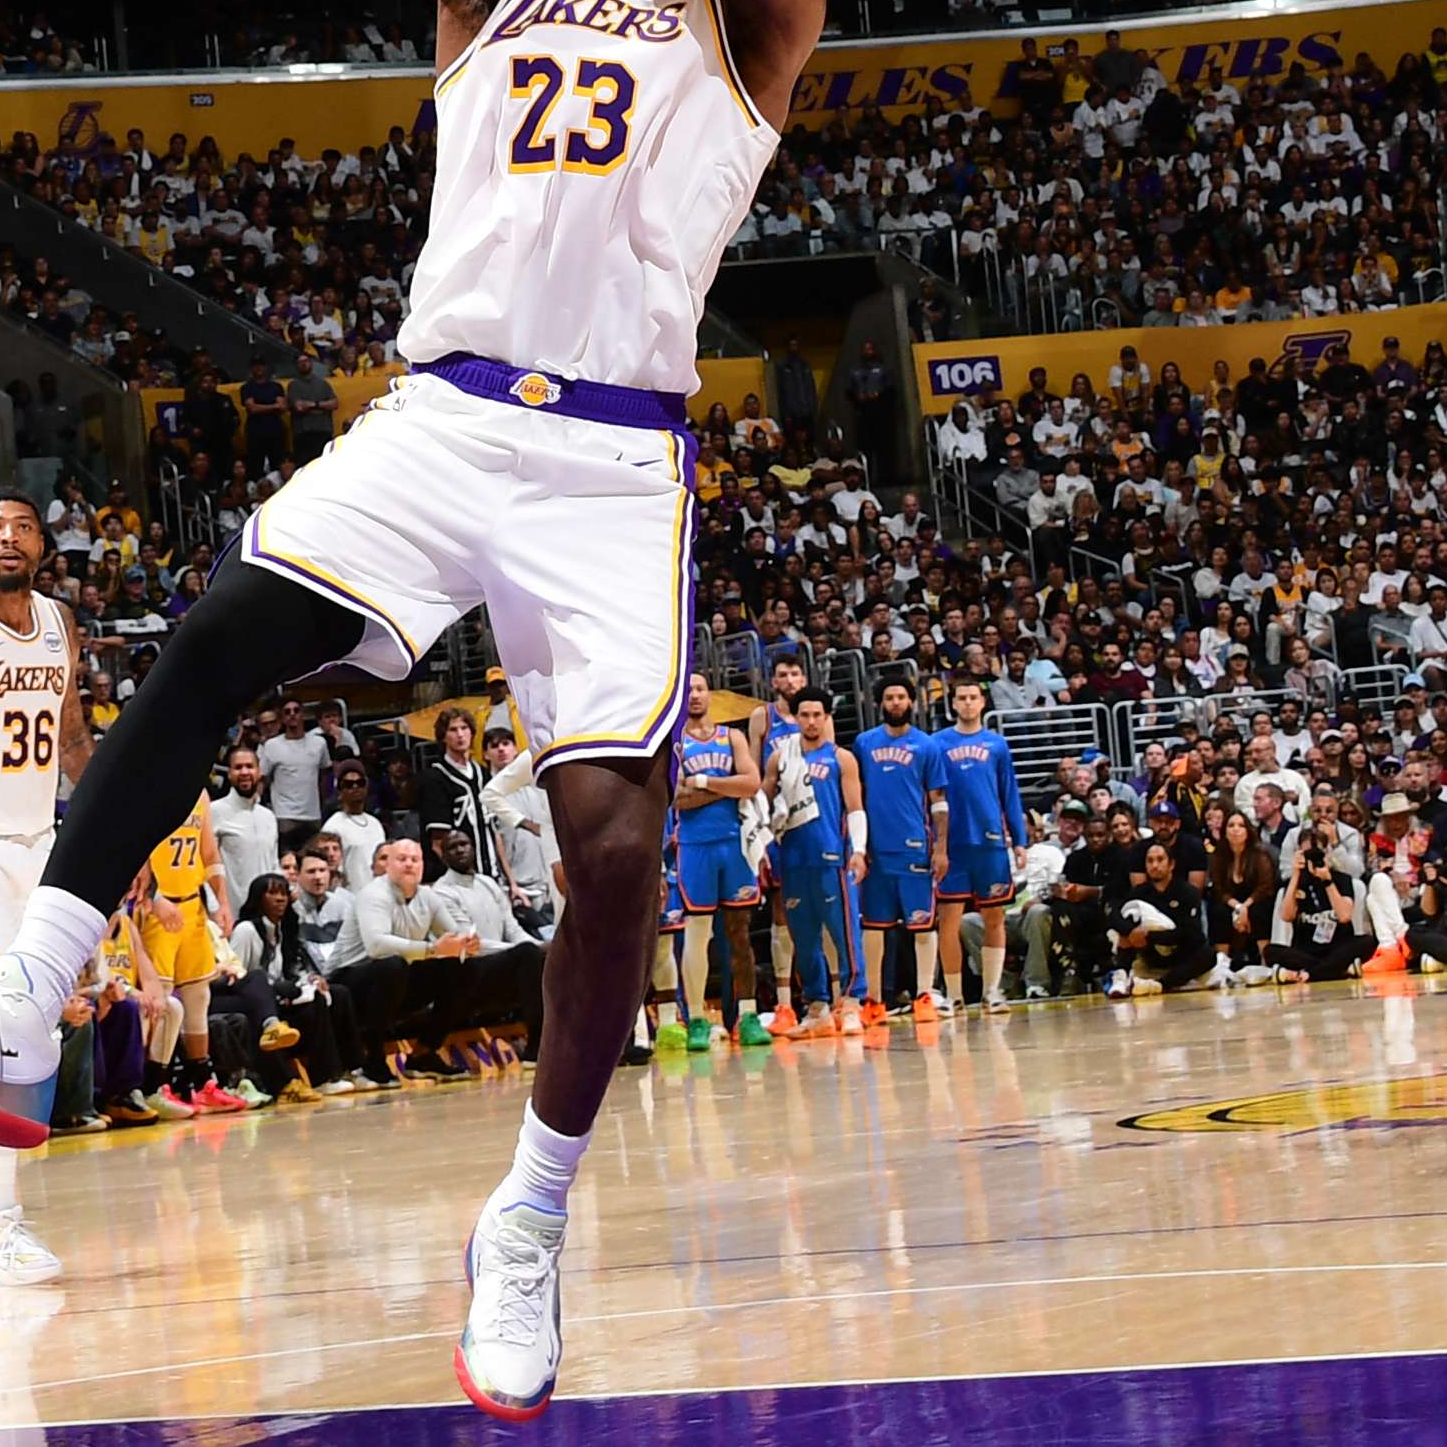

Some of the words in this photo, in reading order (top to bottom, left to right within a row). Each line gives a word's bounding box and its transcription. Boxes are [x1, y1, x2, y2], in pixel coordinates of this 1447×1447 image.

[509, 55, 638, 176] 23
[935, 361, 996, 390] 106
[1, 709, 56, 773] 36
[169, 837, 197, 868] 77
